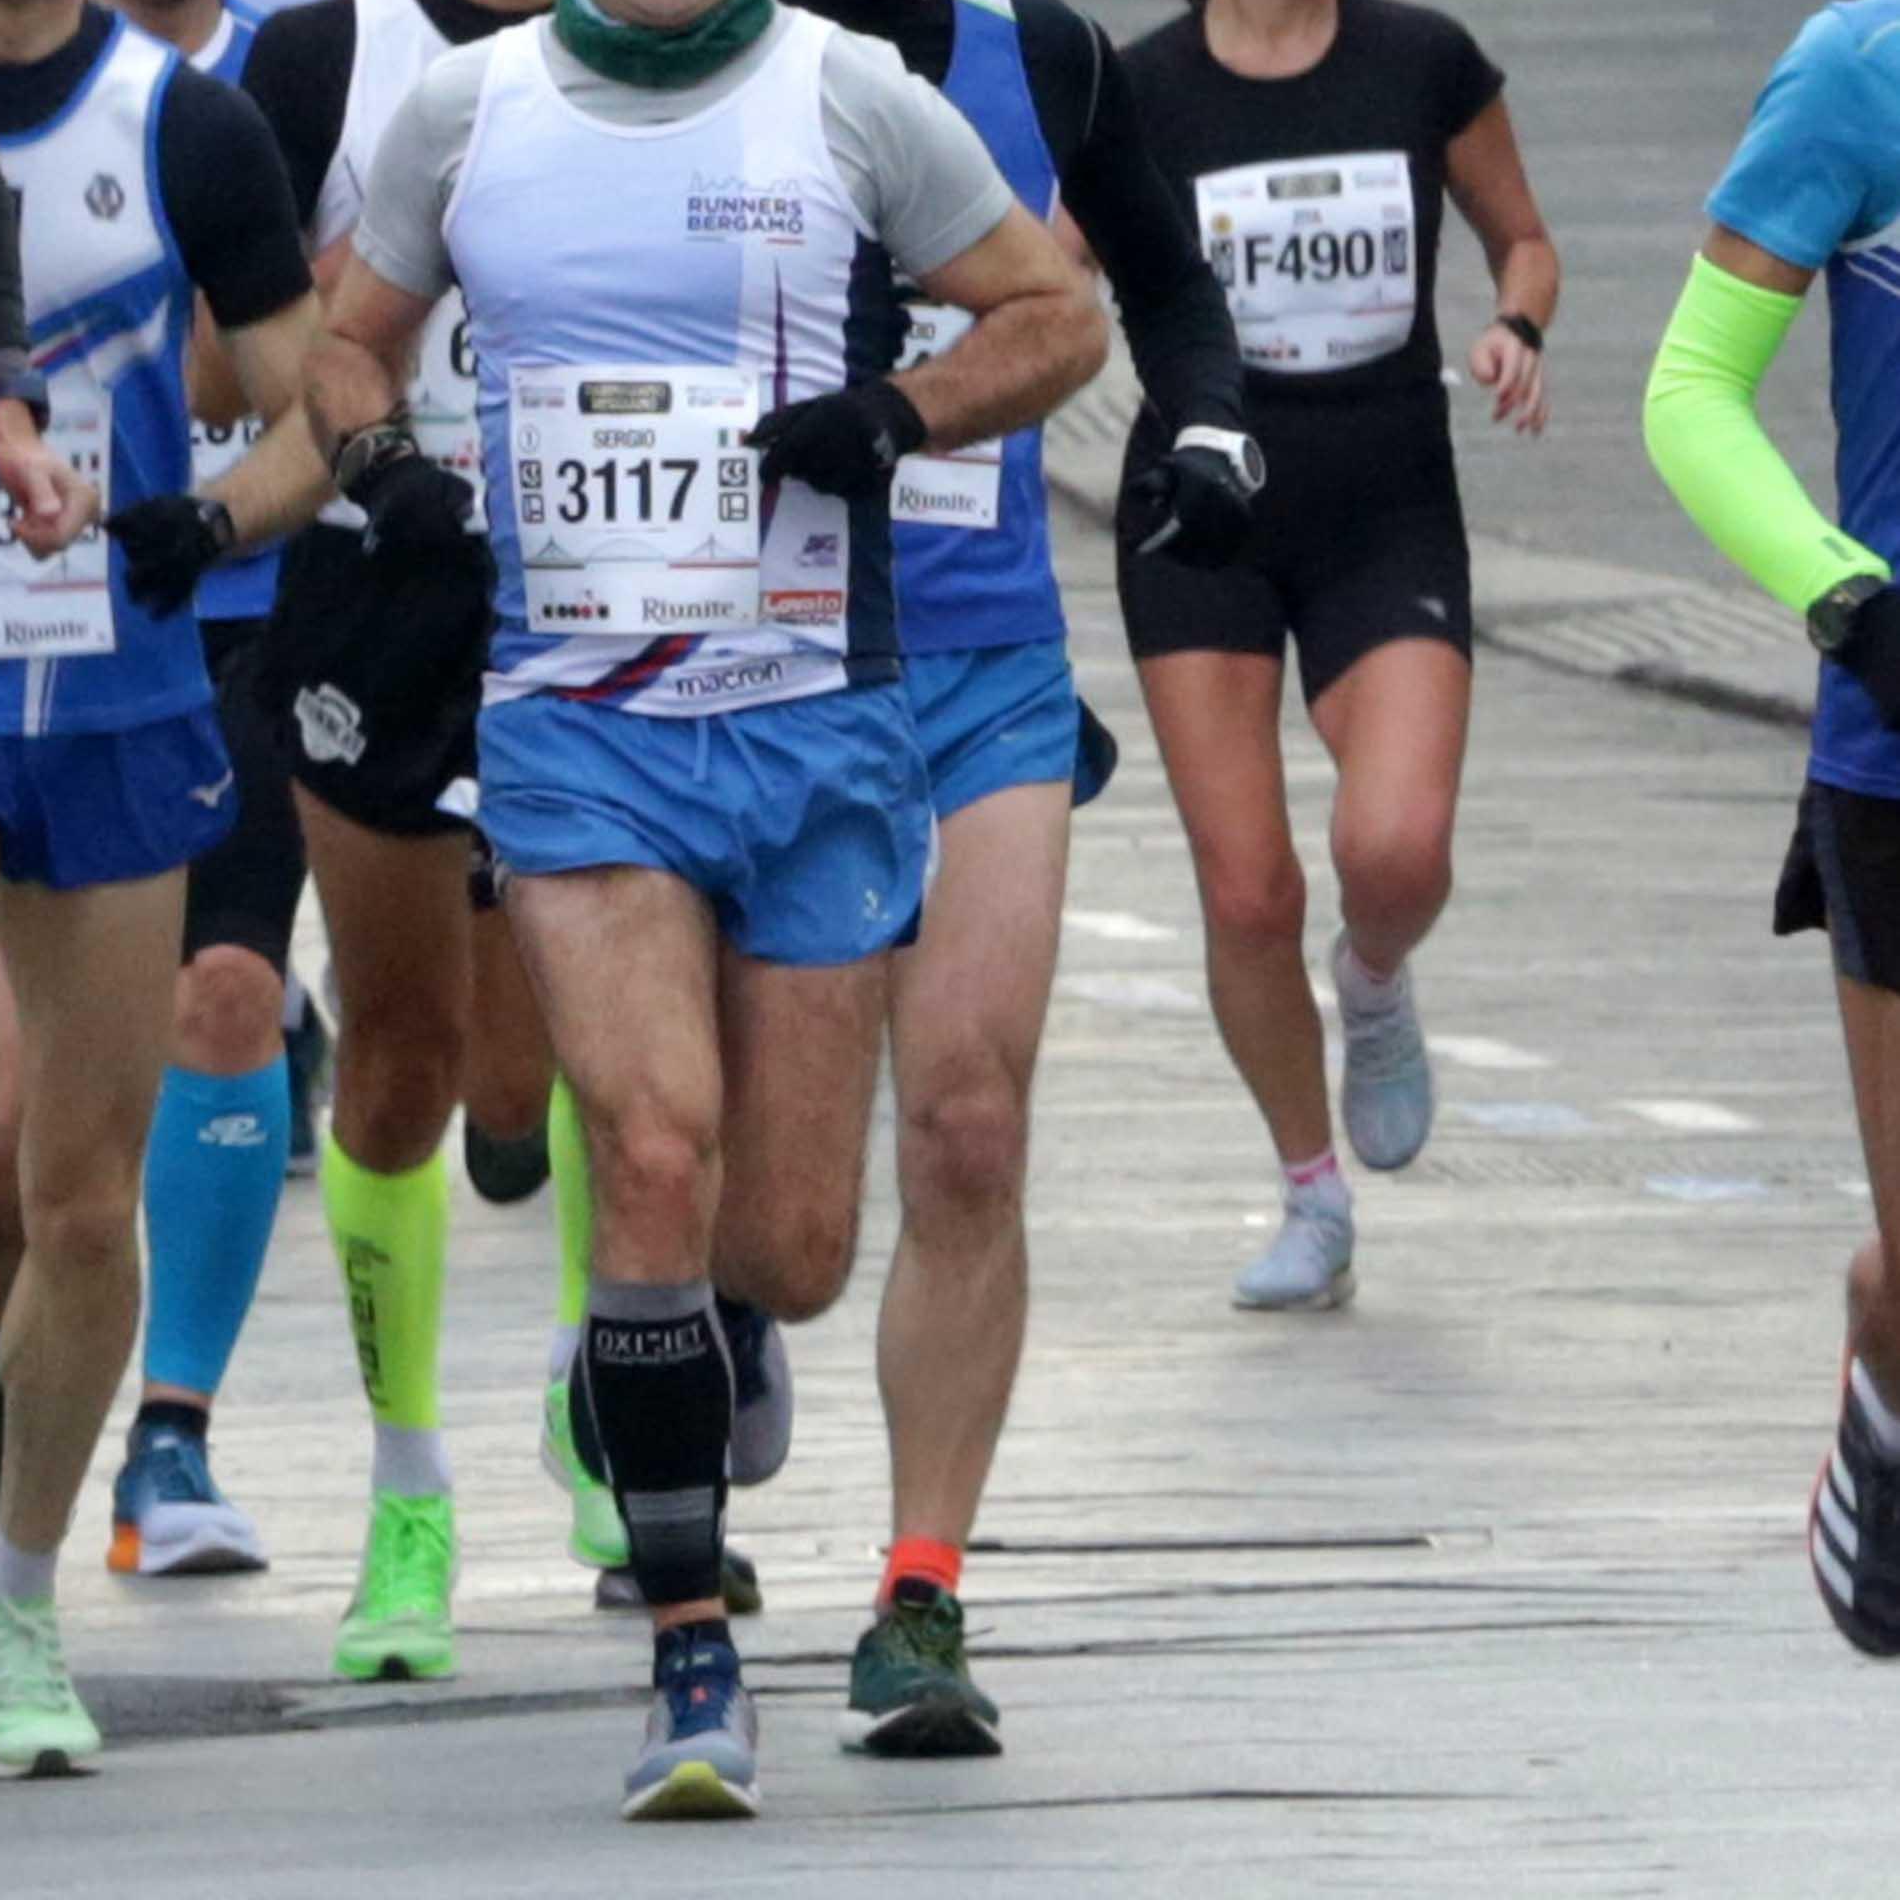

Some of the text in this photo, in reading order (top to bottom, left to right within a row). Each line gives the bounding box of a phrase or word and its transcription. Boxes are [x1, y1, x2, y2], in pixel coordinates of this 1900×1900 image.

[687, 196, 802, 215] RUNNERS
[687, 215, 803, 234] BERGAMO
[1245, 229, 1376, 286] F490
[593, 428, 656, 449] SERGIO
[557, 457, 699, 524] 3117
[642, 598, 735, 626] Riunite
[677, 659, 782, 696] macron
